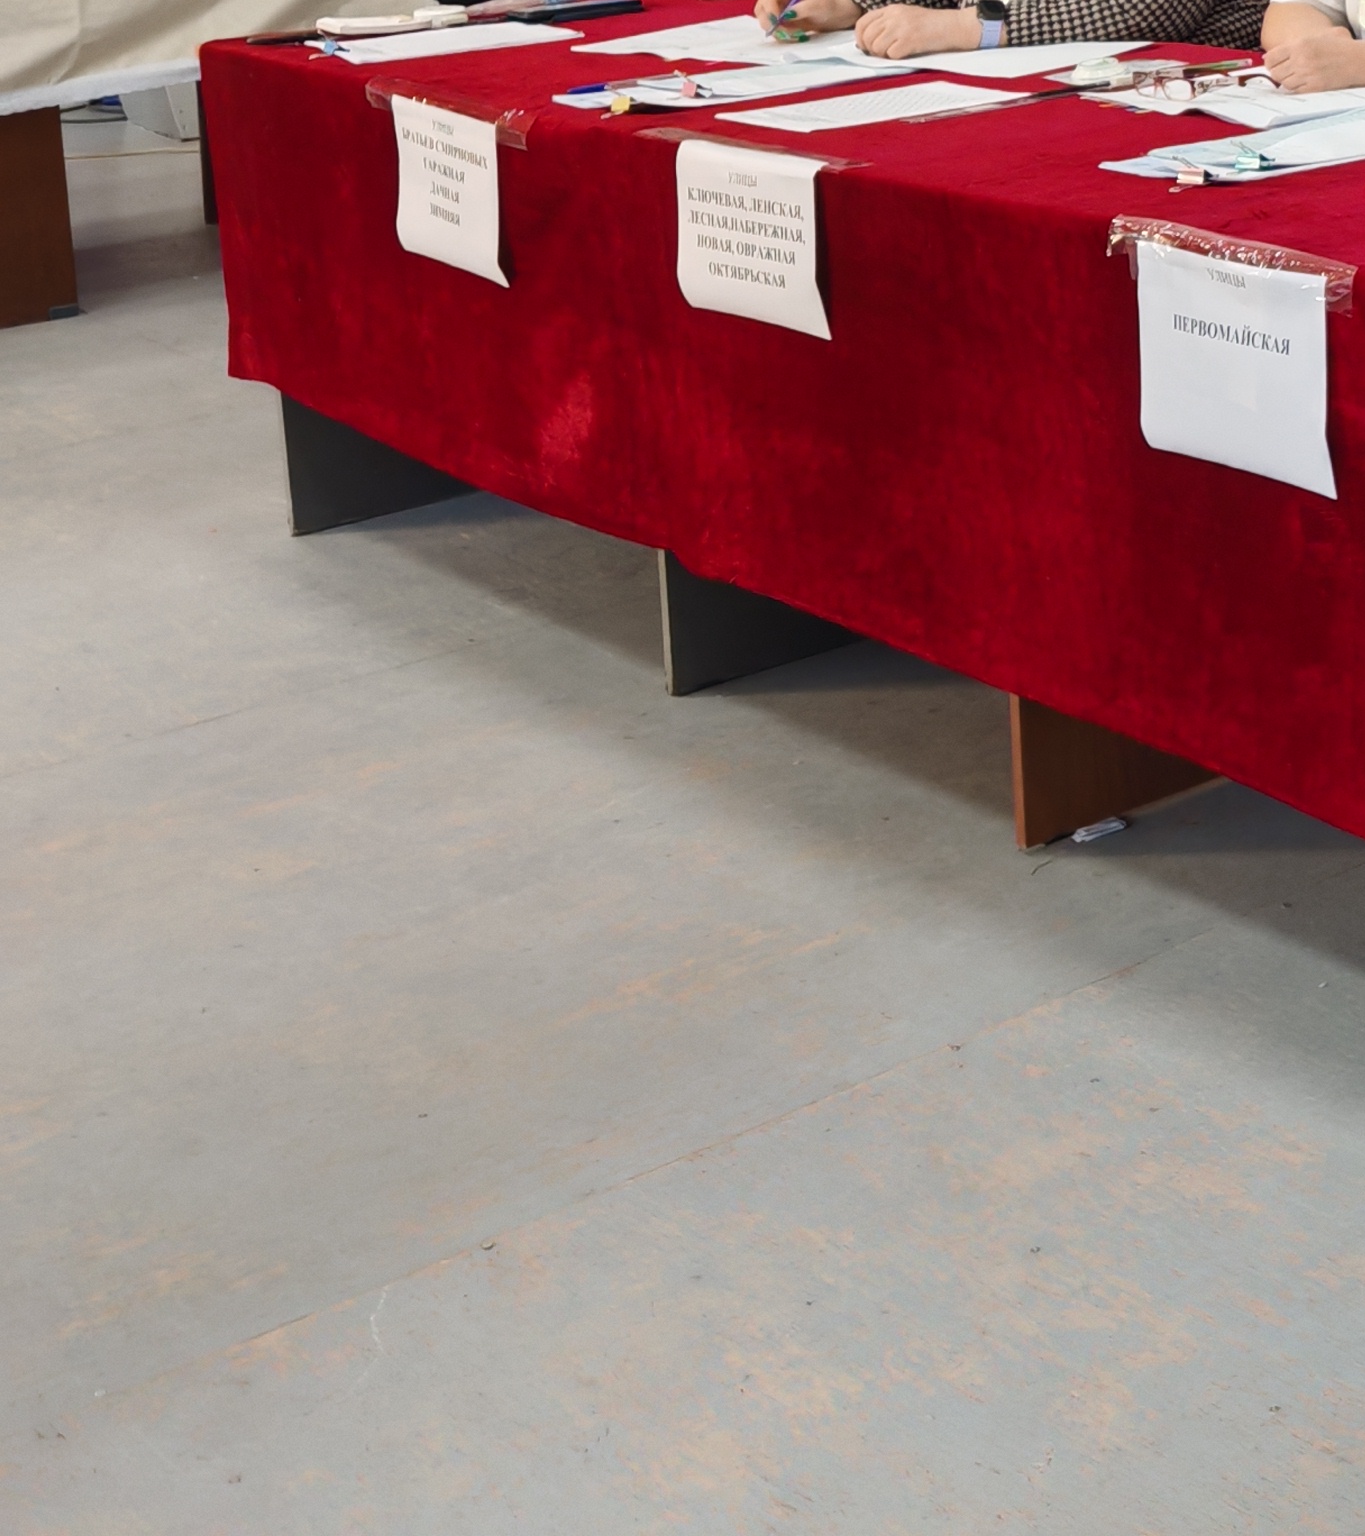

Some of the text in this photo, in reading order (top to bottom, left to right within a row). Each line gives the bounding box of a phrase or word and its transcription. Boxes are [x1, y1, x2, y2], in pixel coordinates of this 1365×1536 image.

[423, 157, 465, 184] ГАРАЖНАЯ
[728, 171, 758, 188] УЛИЦЫ
[430, 181, 460, 204] ДАЧНАЯ
[687, 186, 805, 222] КЛЮЧЕВАЯ, ЛЕНСКАЯ,
[697, 233, 796, 266] НОВАЯ, ОВРАЖНАЯ
[708, 261, 787, 289] ОКТЯБРЬСКАЯ
[1207, 267, 1247, 289] УЛИЦЫ
[1173, 313, 1291, 356] ПЕРВОМАЙСКАЯ
